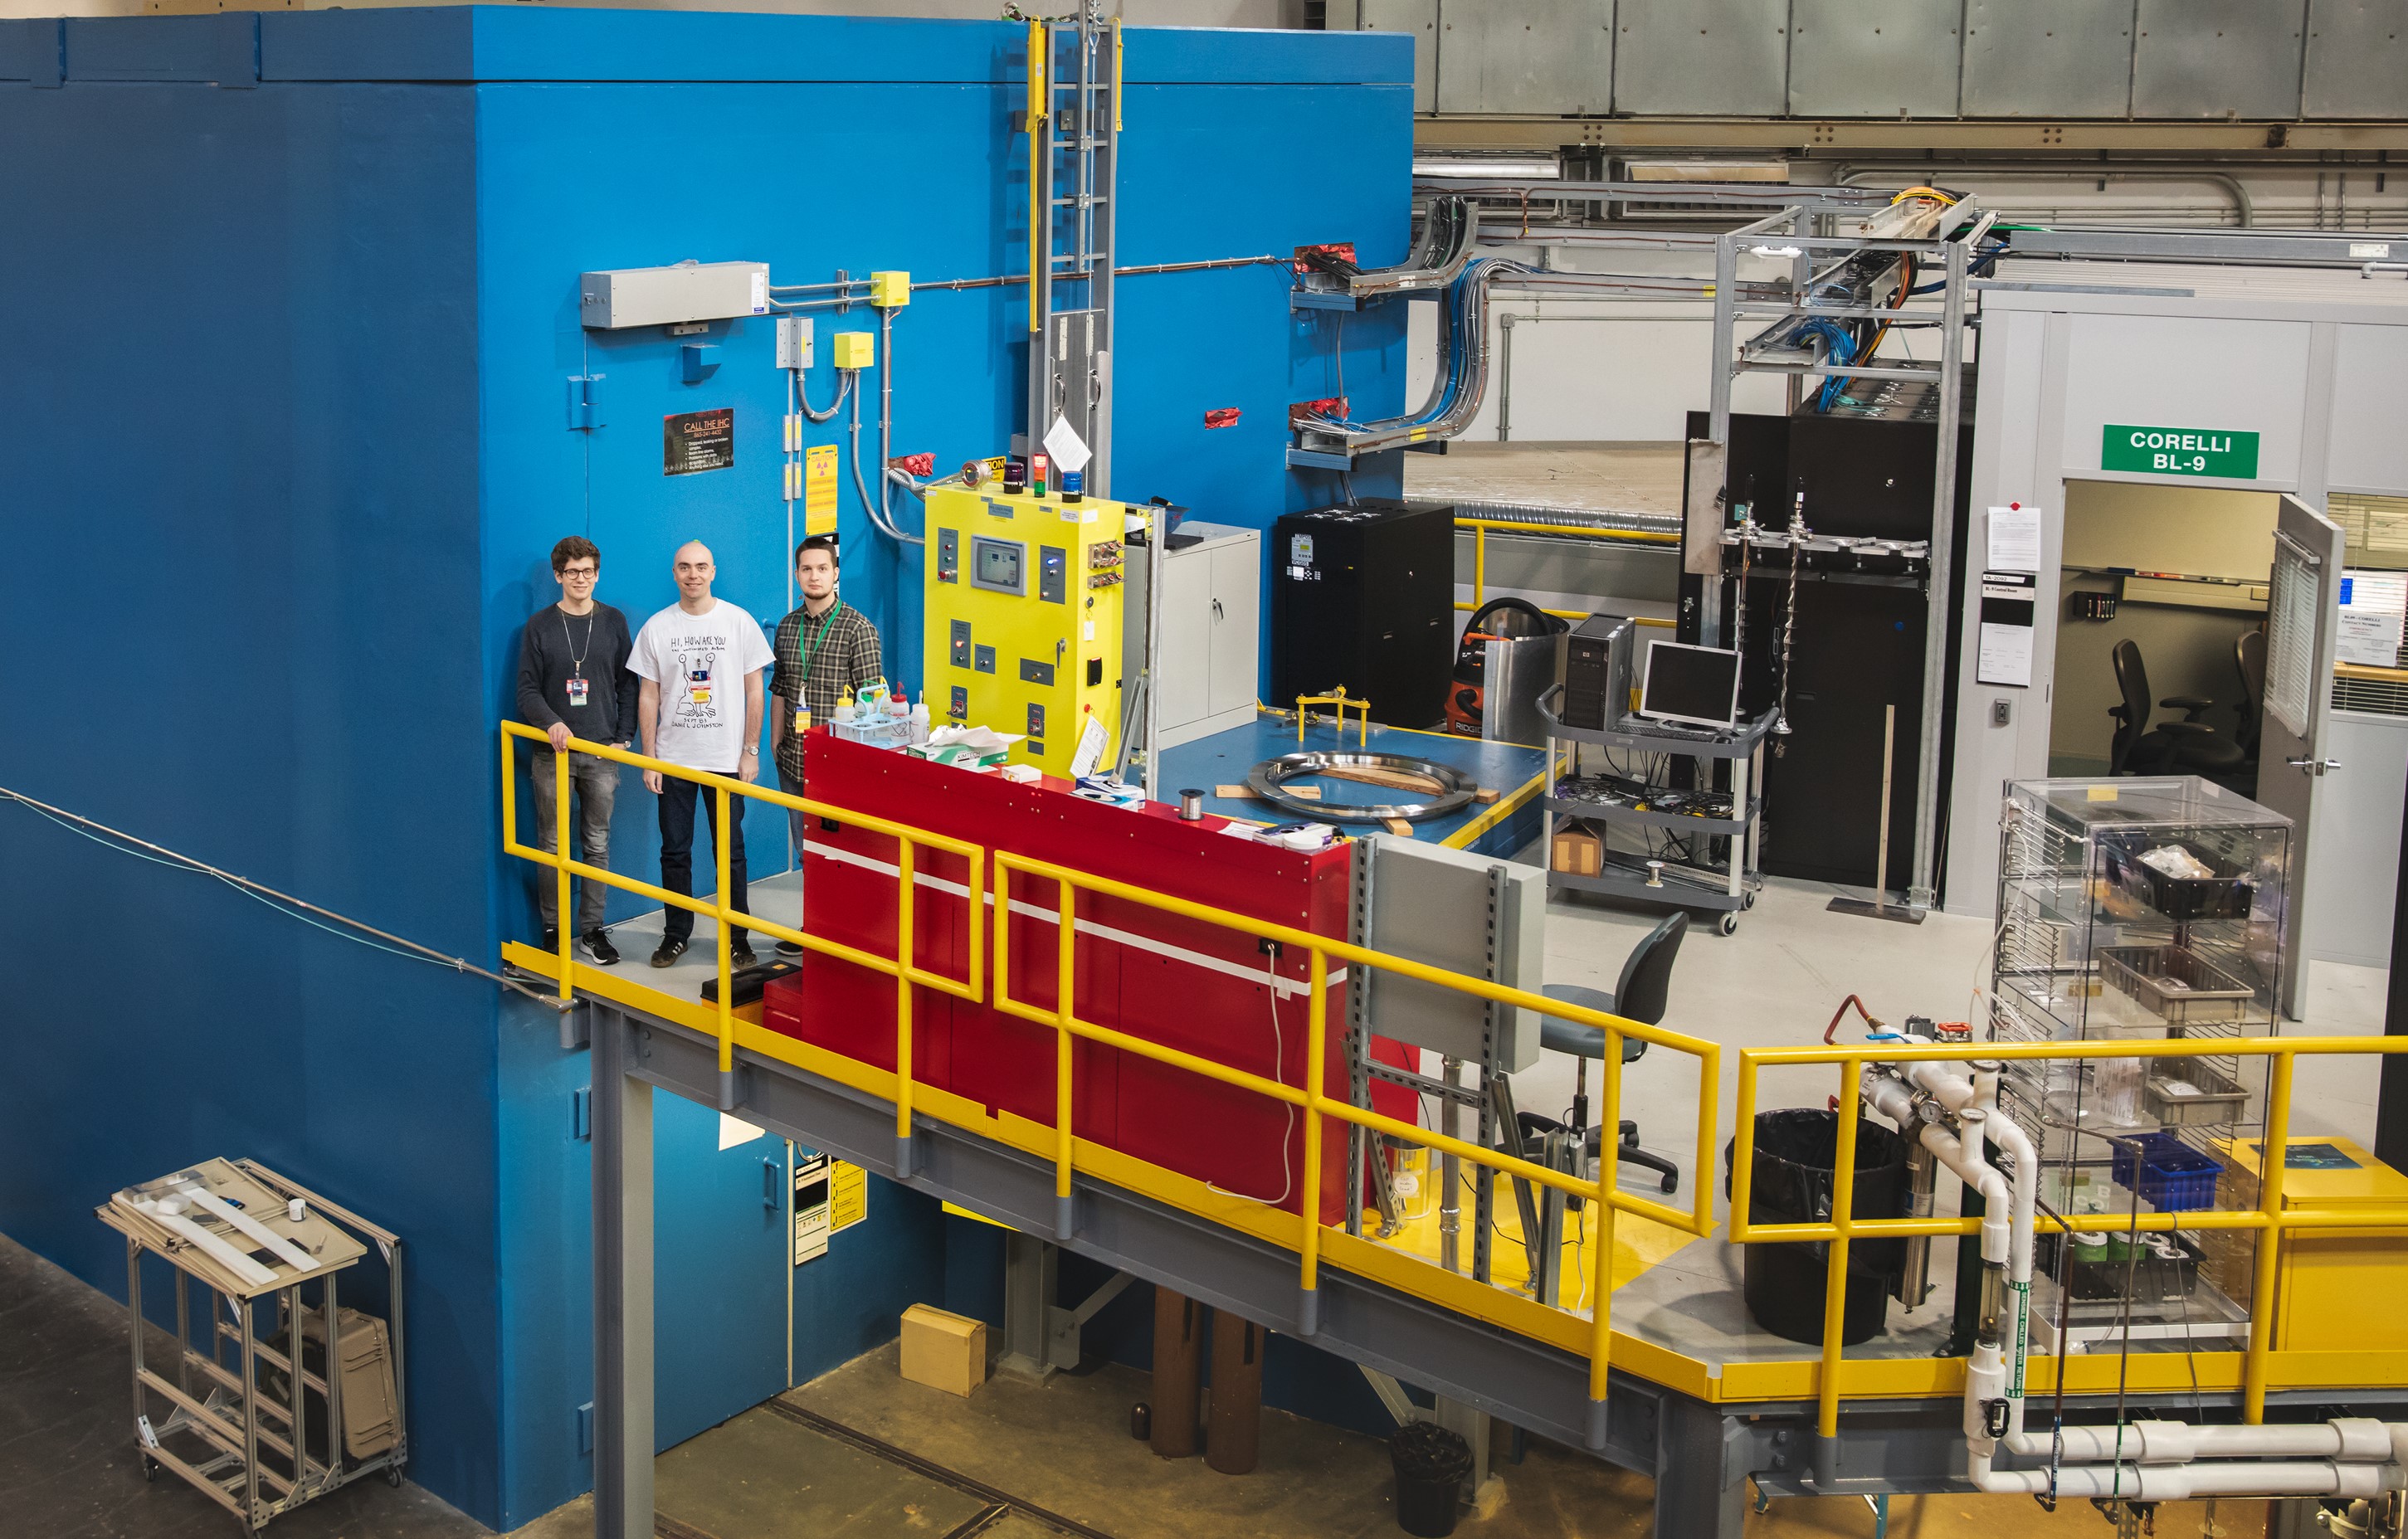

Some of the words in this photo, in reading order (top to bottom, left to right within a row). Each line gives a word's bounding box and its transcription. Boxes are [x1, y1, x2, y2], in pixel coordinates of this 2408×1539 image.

[684, 422, 702, 431] CALL
[704, 420, 716, 429] THE
[717, 418, 730, 427] IHC
[2130, 432, 2231, 453] CORELLI
[812, 454, 833, 463] CAUTION
[2153, 453, 2206, 471] BL-9
[670, 637, 683, 648] HI,
[685, 636, 702, 646] HOW
[702, 636, 713, 645] ARE
[714, 636, 726, 645] YOU
[957, 751, 980, 759] KIMTECH
